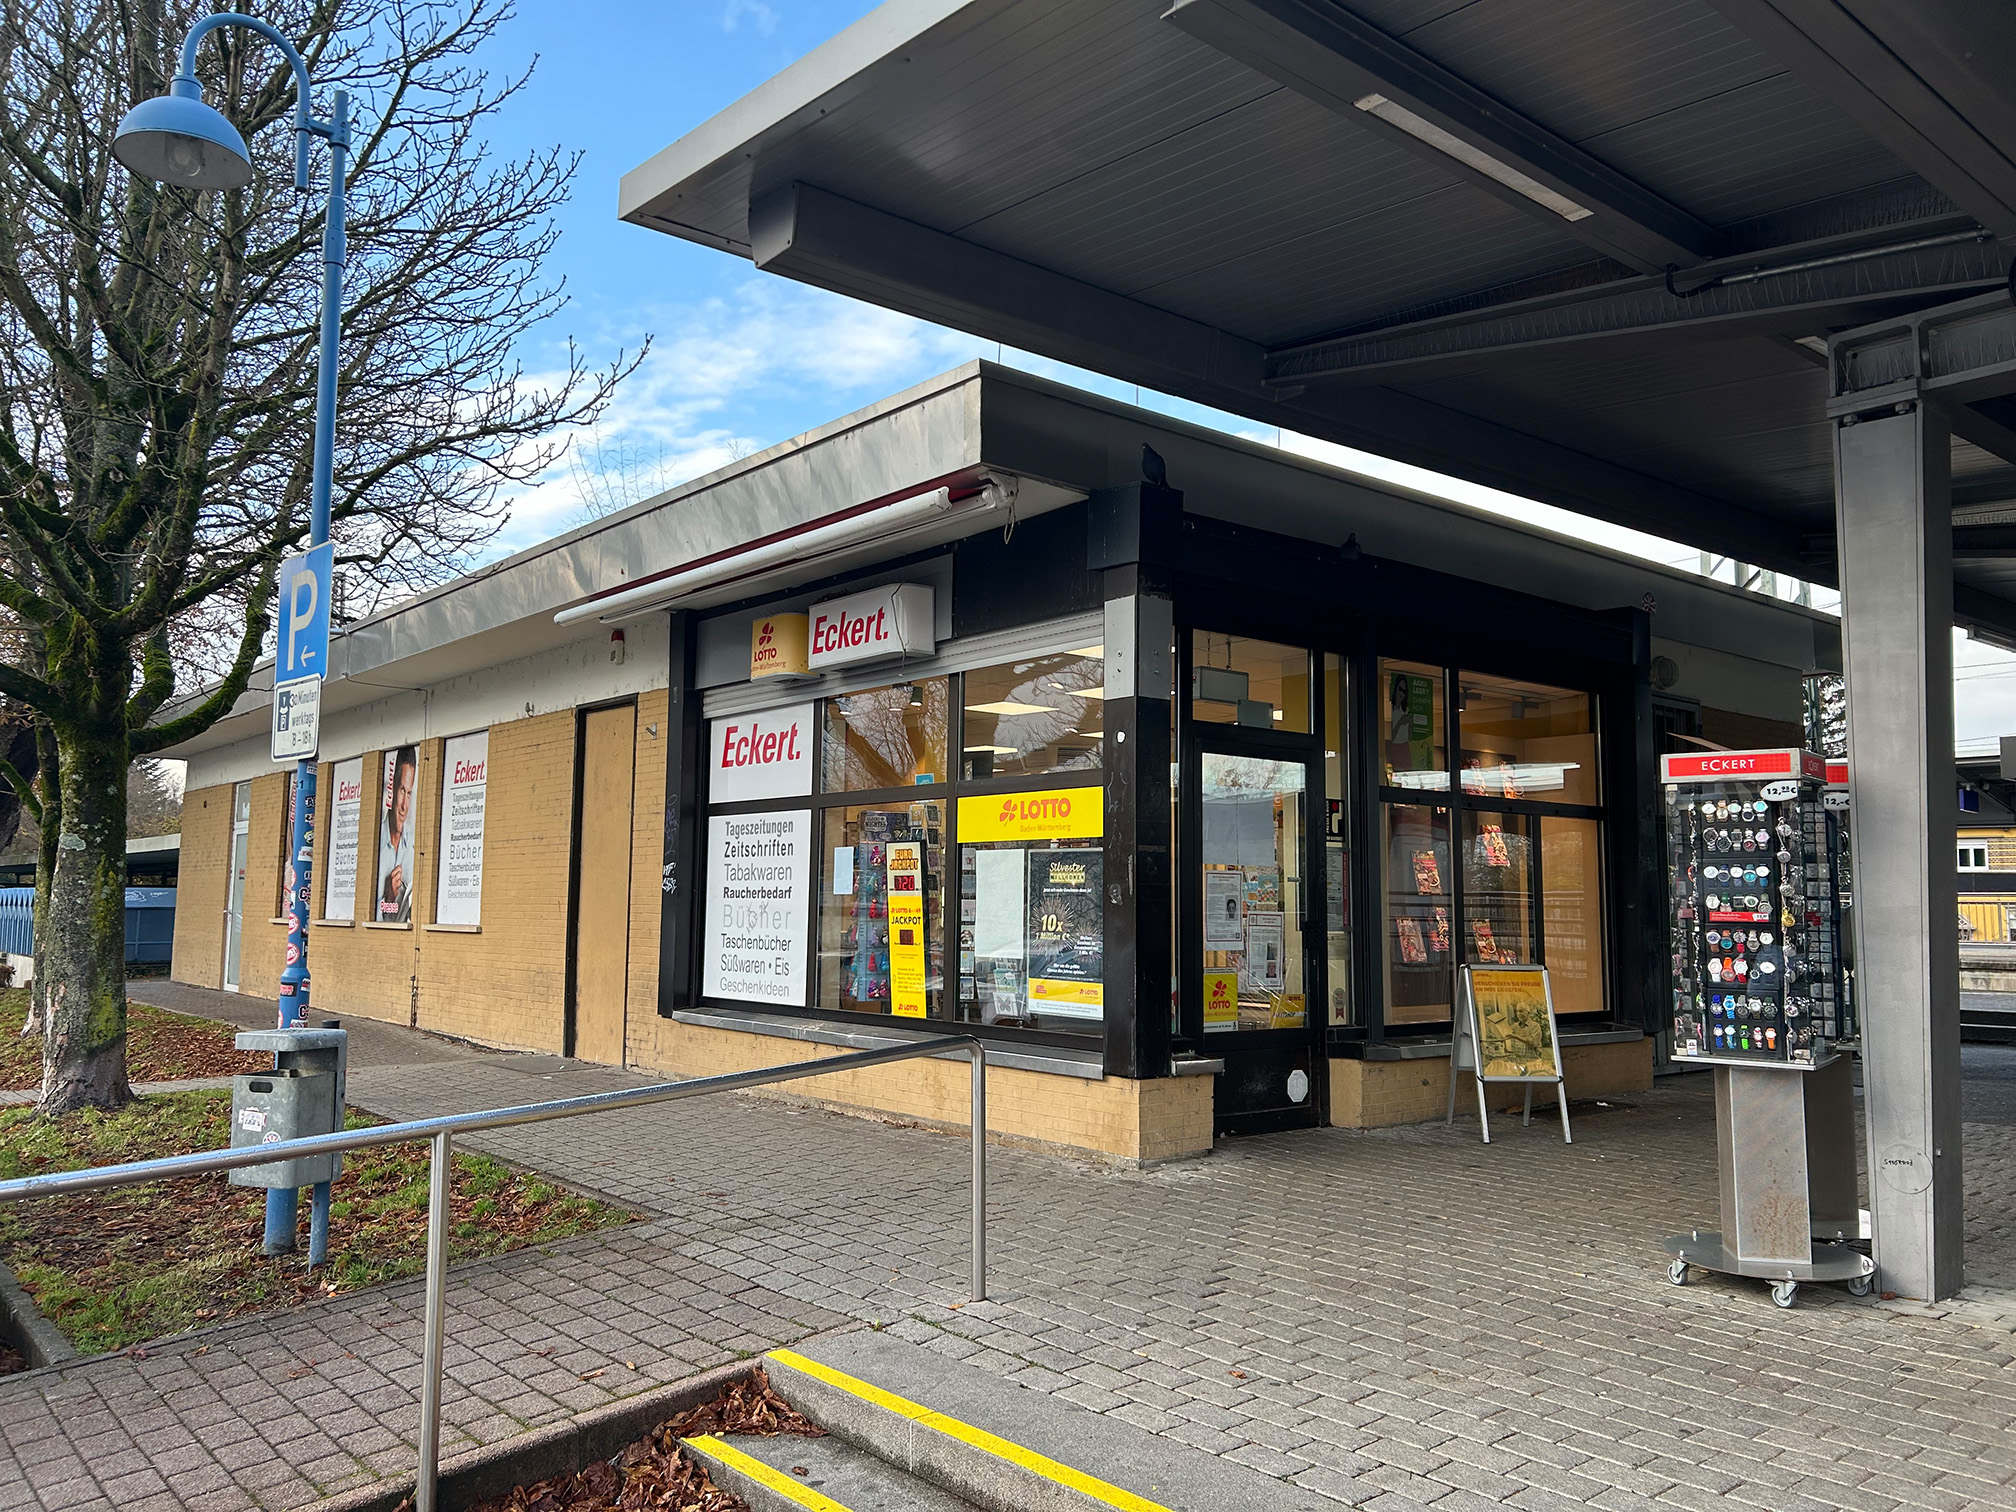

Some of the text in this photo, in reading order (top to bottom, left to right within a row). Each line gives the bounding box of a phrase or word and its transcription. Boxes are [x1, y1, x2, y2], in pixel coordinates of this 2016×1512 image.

[287, 569, 318, 671] P
[812, 606, 889, 655] Eckert.
[754, 647, 777, 662] LOTTO
[292, 712, 315, 727] werktags
[721, 721, 802, 769] Eckert.
[454, 760, 486, 784] Eckert.
[1701, 759, 1755, 771] ECKERT
[386, 758, 395, 809] Eckert.
[452, 804, 484, 817] Zeitschriften
[1020, 797, 1071, 820] LOTTO
[452, 819, 482, 830] Tabakwaren
[725, 819, 794, 839] Tageszeitungen
[451, 831, 482, 841] Raucherbedarf
[450, 844, 482, 860] Bücher
[724, 839, 794, 858] Zeitschriften
[895, 849, 913, 860] EURO
[449, 862, 482, 873] Taschenbücher
[724, 863, 792, 881] Tabakwaren
[889, 859, 919, 870] JACKPOT
[1049, 862, 1086, 873] Silvester
[448, 875, 480, 887] Süßwaren Eis
[723, 886, 792, 899] Raucherbedarf
[380, 900, 399, 913] Presse
[723, 904, 791, 930] Bücher
[891, 916, 921, 925] JACKPOT
[1041, 914, 1063, 932] 10x
[721, 933, 792, 951] Taschenbücher
[720, 953, 790, 976] Süßwaren Eis
[720, 976, 790, 997] Geschenkideen
[904, 1003, 918, 1012] LOTTO
[1208, 1000, 1231, 1010] LOTTO
